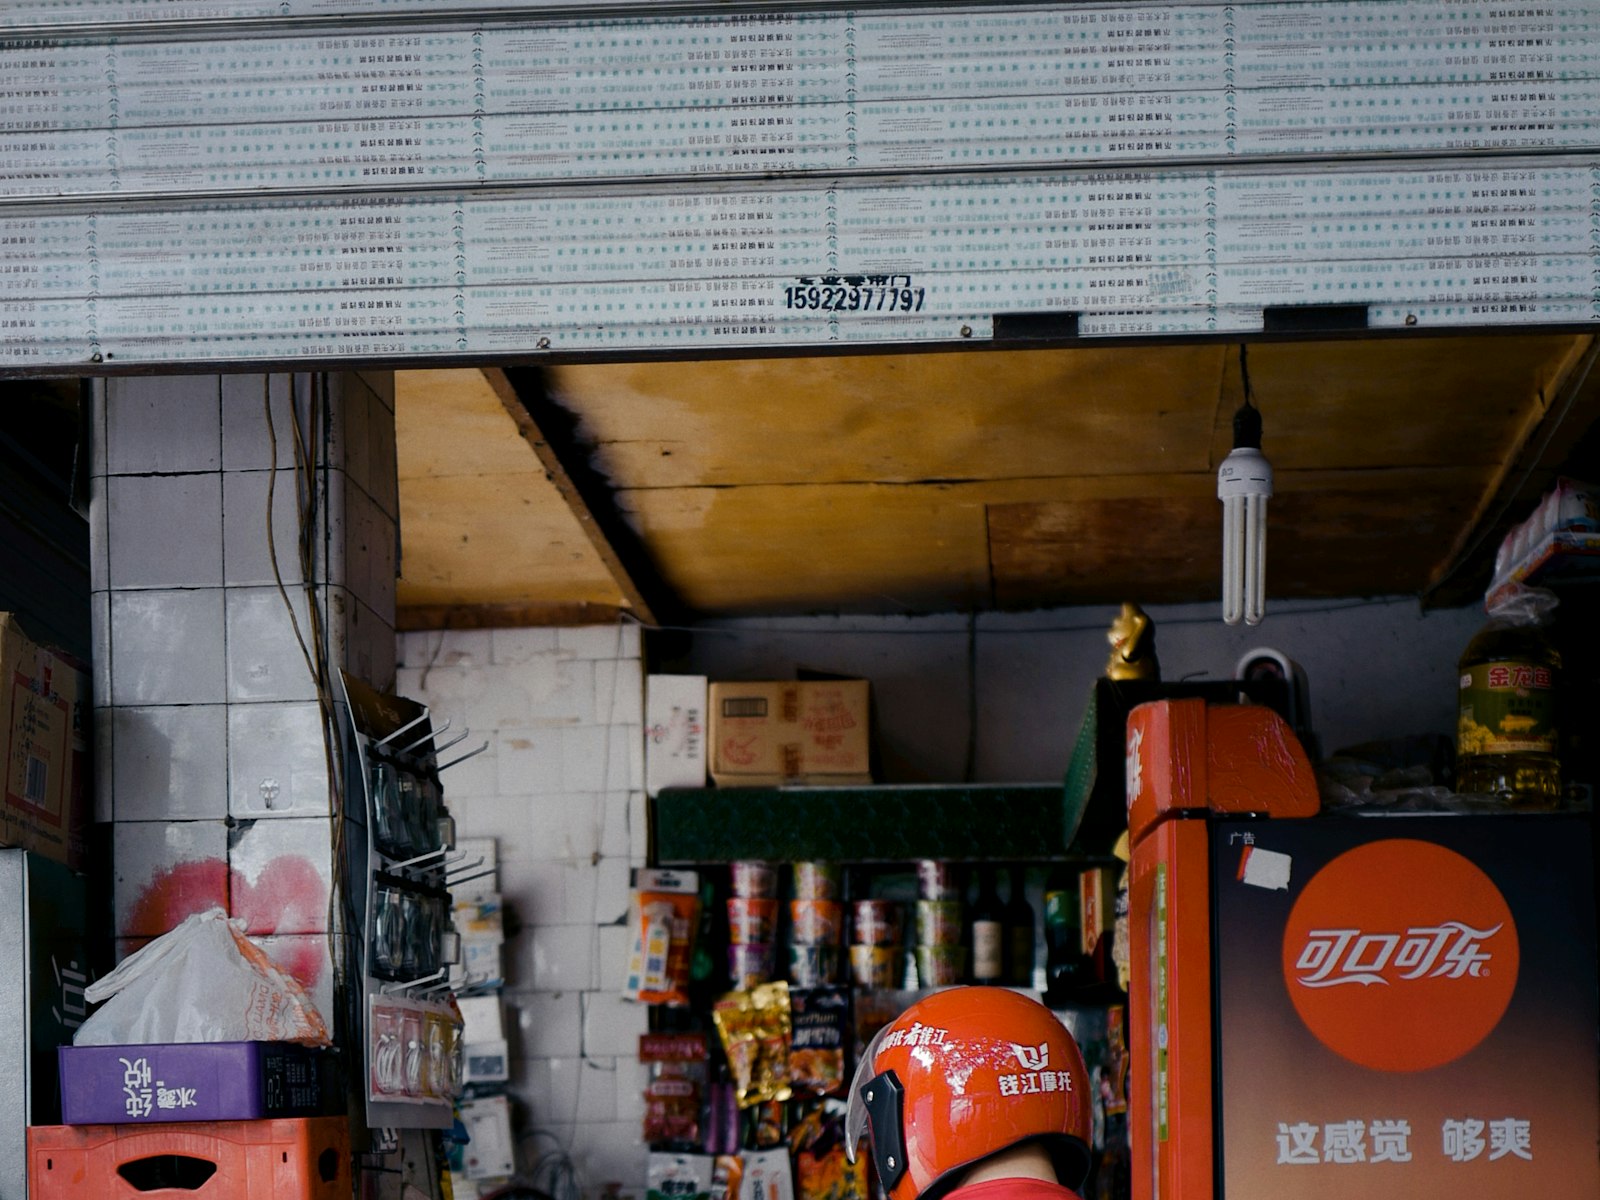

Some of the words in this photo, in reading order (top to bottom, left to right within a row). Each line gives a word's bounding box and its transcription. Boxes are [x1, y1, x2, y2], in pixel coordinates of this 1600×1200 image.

[785, 287, 925, 312] 15922977797
[1489, 666, 1552, 688] 金龙鱼
[1230, 832, 1255, 845] 广告
[1297, 922, 1503, 986] 可口可乐
[999, 1071, 1072, 1096] 钱江摩托
[1275, 1120, 1413, 1165] 这感觉
[1442, 1118, 1533, 1162] 够爽
